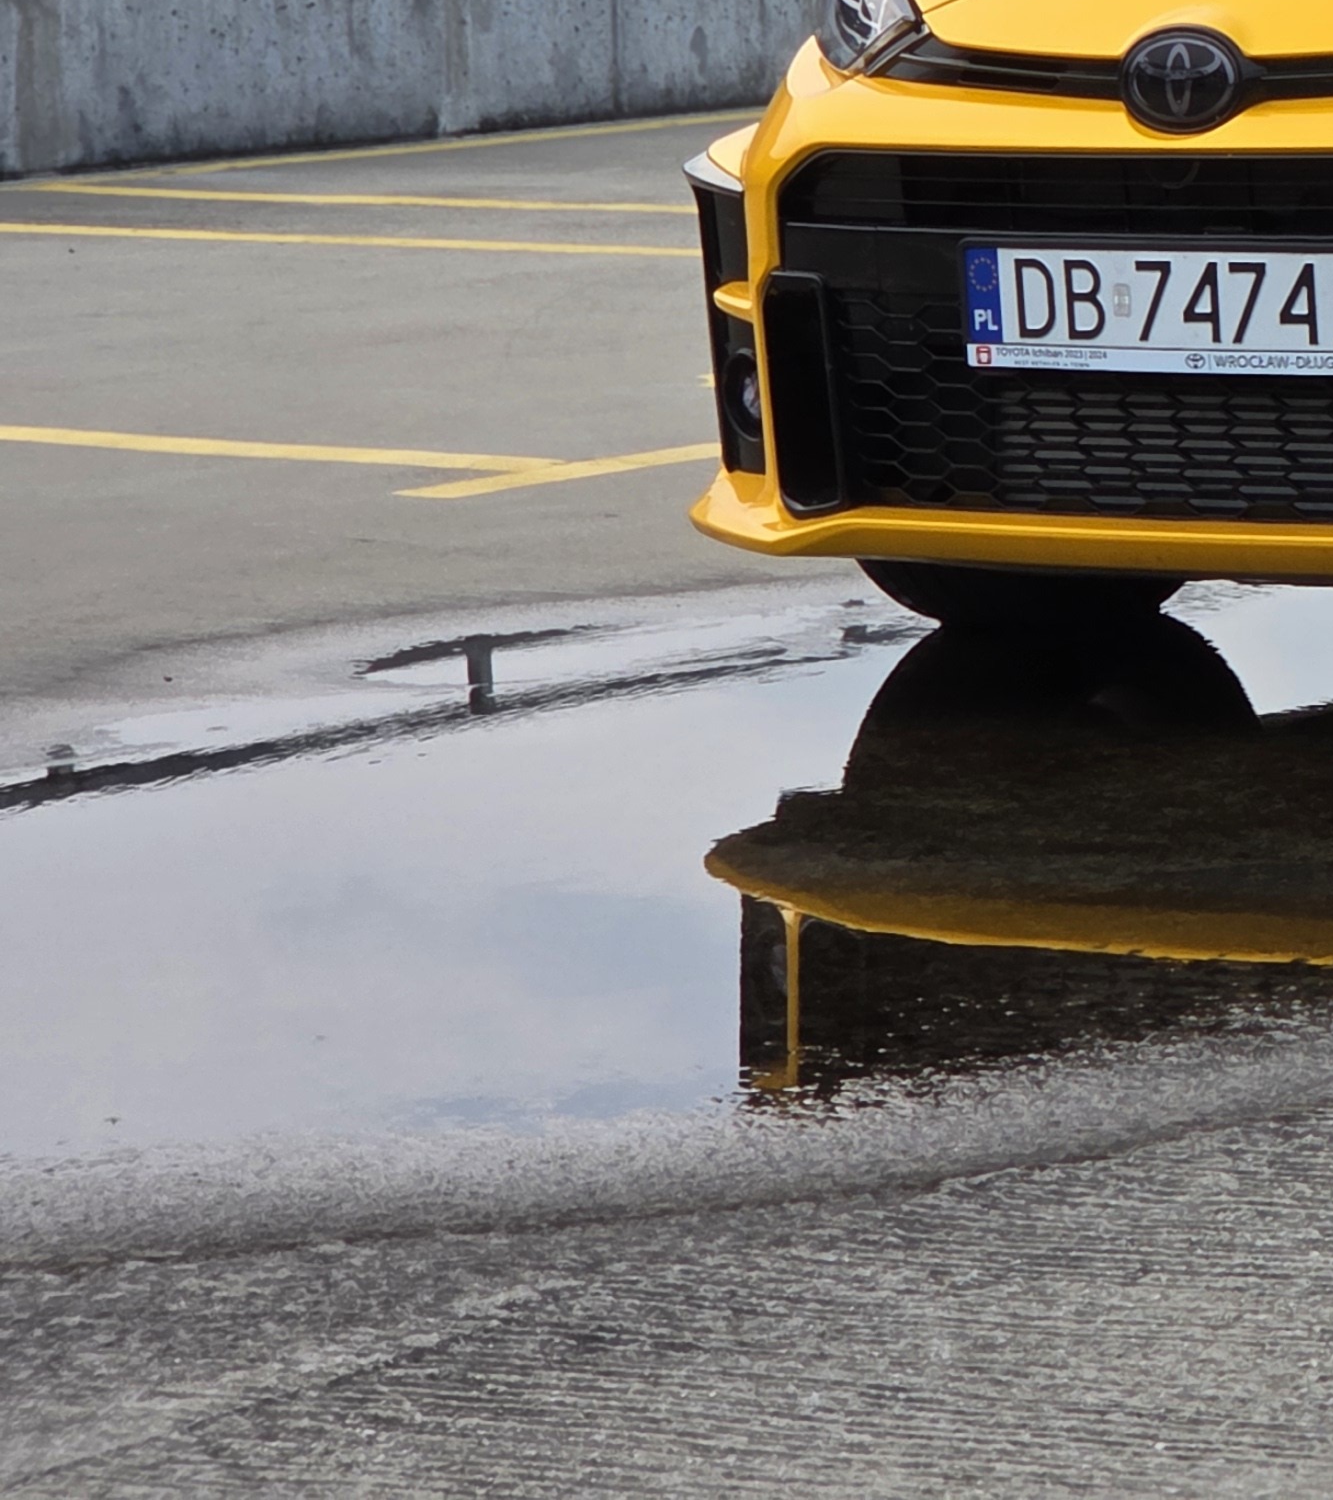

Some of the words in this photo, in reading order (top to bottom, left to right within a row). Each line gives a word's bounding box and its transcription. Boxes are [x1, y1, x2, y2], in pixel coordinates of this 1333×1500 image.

[1014, 258, 1106, 340] DB
[974, 308, 999, 331] PL
[996, 347, 1030, 357] TOYOTA
